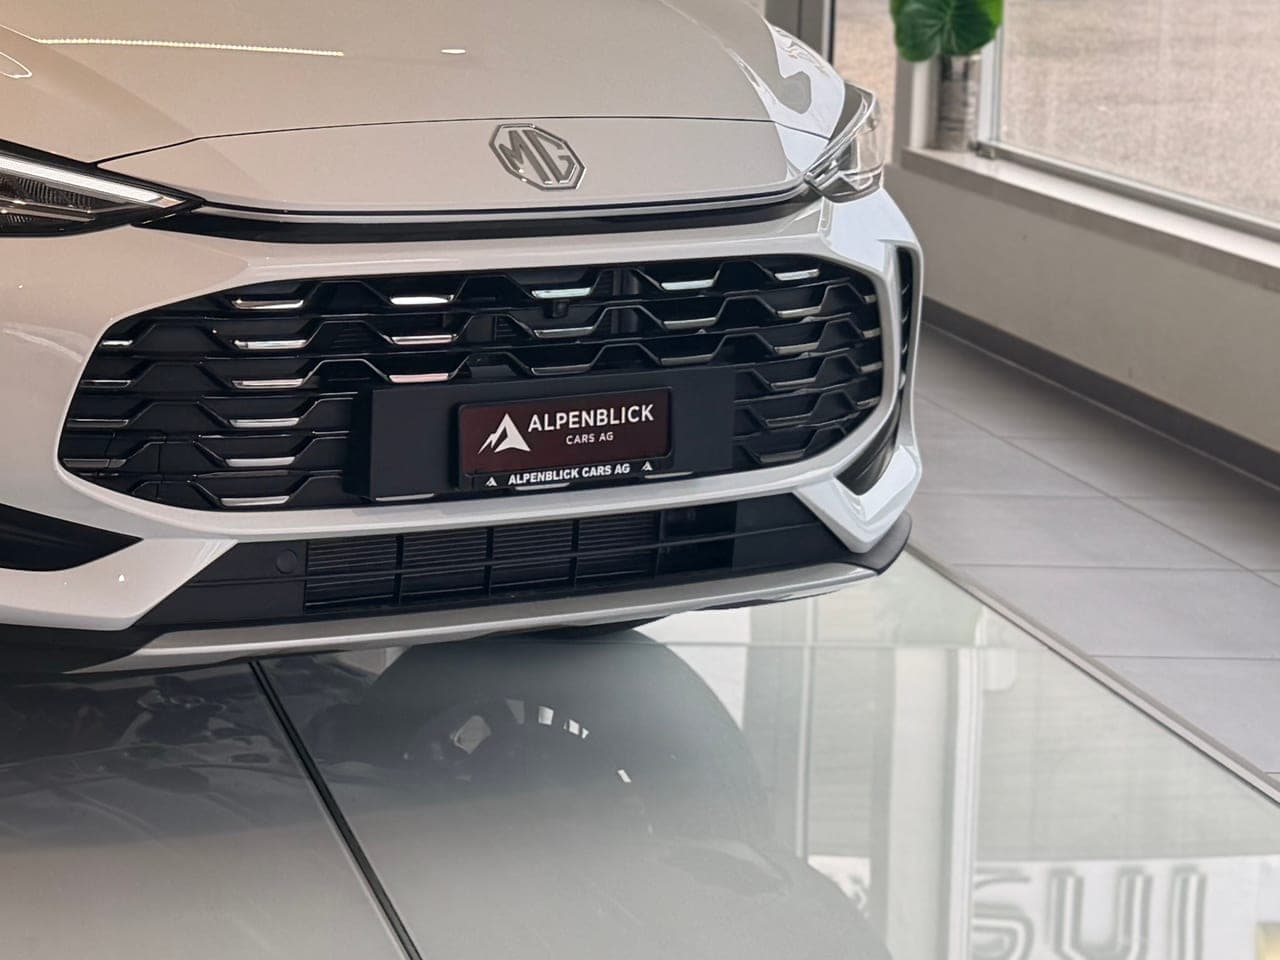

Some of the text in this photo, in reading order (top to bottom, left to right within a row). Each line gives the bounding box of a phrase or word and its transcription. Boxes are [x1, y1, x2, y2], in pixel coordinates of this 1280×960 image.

[495, 127, 579, 187] MG
[527, 403, 655, 433] ALPENBLICK
[565, 431, 615, 445] CARS AG
[507, 463, 631, 486] ALPENBLICK CARS AG
